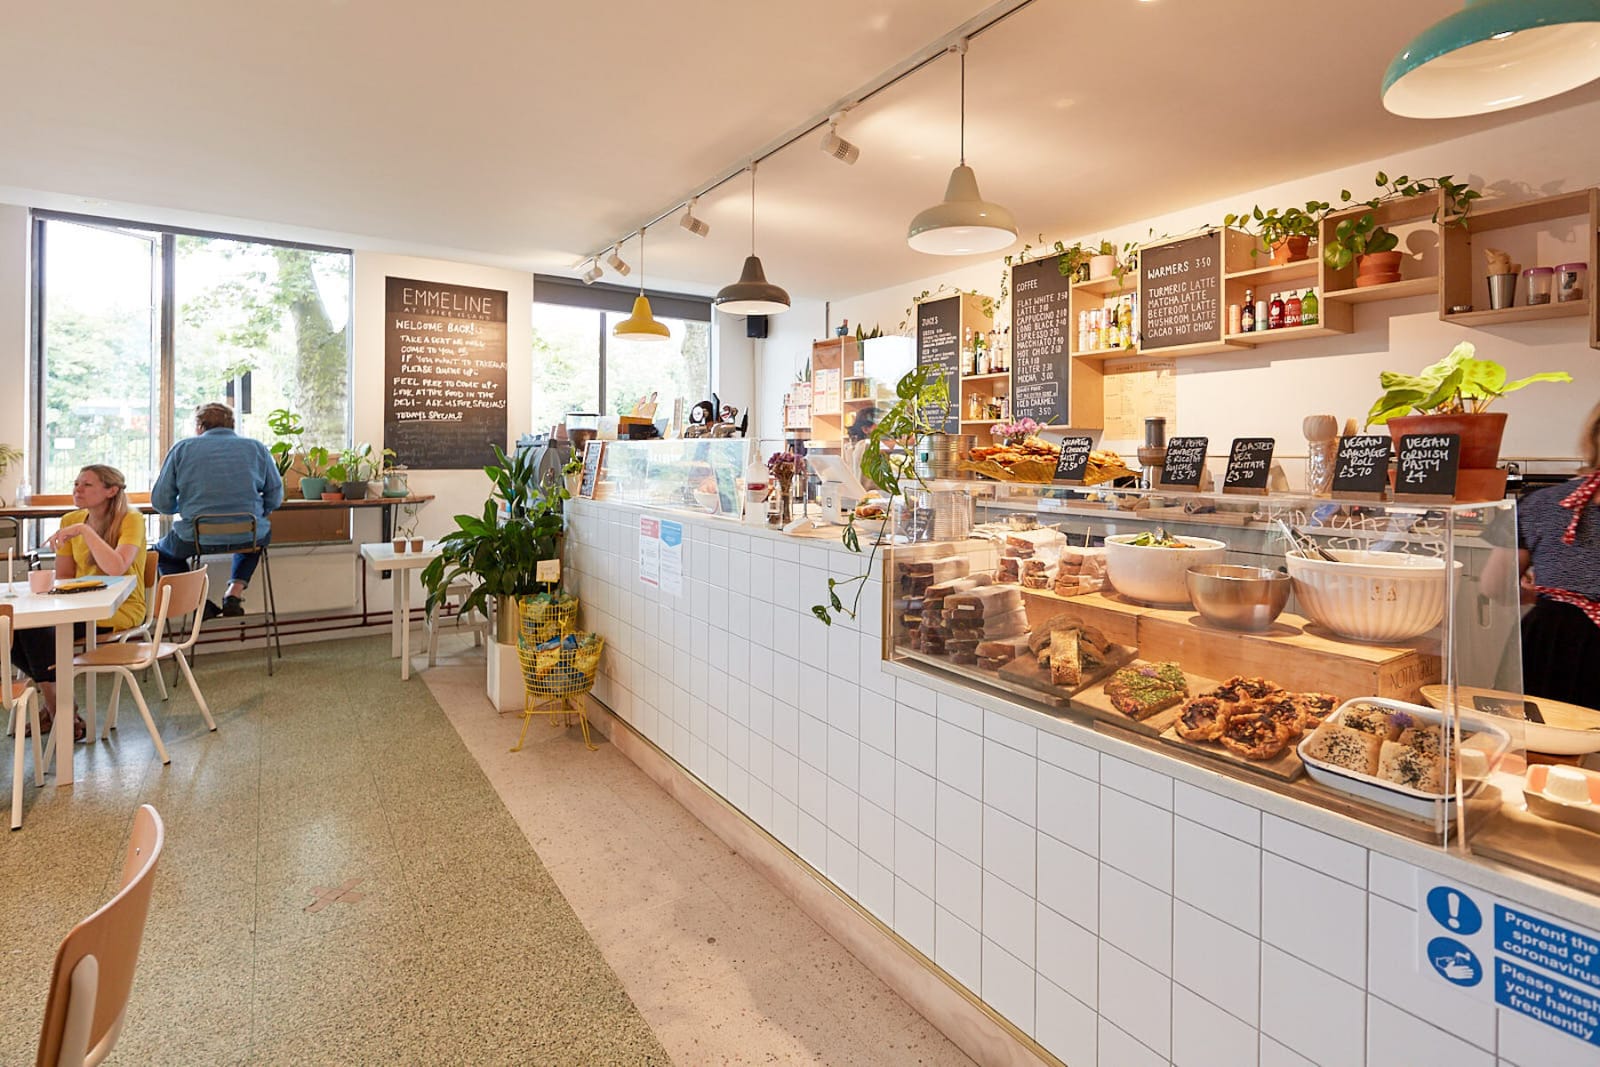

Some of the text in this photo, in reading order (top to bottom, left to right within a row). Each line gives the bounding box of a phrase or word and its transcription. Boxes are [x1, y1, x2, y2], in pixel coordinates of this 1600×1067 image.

[1147, 260, 1190, 279] WARMERS
[1016, 279, 1038, 292] COFFEE
[1148, 276, 1217, 298] TURMERIC LATTE
[403, 287, 492, 315] EMMELINE
[1017, 298, 1032, 309] FLAT
[1033, 293, 1055, 305] WHITE
[1147, 289, 1208, 309] MATCHA LATTE
[1016, 304, 1037, 317] LATTE
[1147, 298, 1217, 319] BEETROOT LATTE
[1016, 311, 1054, 326] CAPPUCCINO
[1147, 309, 1217, 328] MUSHROOM LATTE
[395, 319, 443, 332] WELCOME
[1016, 323, 1032, 335] LONG
[1034, 319, 1054, 331] BLACK
[1147, 326, 1173, 338] CACAO
[400, 335, 422, 344] TAKE
[424, 336, 430, 344] A
[1016, 329, 1049, 342] ESPRESSO
[400, 345, 425, 354] COME
[427, 346, 437, 354] TO
[438, 347, 454, 356] YOU
[1016, 350, 1029, 358] HOT
[1031, 345, 1049, 357] CHOC
[401, 355, 412, 363] IF
[415, 355, 433, 364] YOU
[1017, 358, 1030, 367] TEA
[401, 365, 433, 374] PLEASE
[1017, 364, 1041, 376] FILTER
[393, 377, 420, 387] FEEL
[444, 380, 455, 389] TO
[456, 381, 480, 389] COME
[1017, 373, 1037, 384] MOCHA
[416, 388, 427, 396] AT
[444, 390, 465, 399] FOOD
[477, 391, 495, 399] THE
[394, 399, 416, 408] DELI
[1016, 408, 1034, 417] LATTE
[1235, 441, 1274, 453] ROASTED
[1344, 436, 1383, 449] VEGAN
[1406, 436, 1450, 450] VEGAN
[1339, 447, 1388, 459] SAUSAGE
[1400, 449, 1449, 461] CORNISH
[1351, 456, 1375, 467] ROLL
[1402, 459, 1440, 471] PASTY
[1405, 470, 1428, 483] £4
[1269, 507, 1324, 530] KIDS
[1505, 911, 1599, 955] Prevent the
[1512, 930, 1591, 967] spread of
[1501, 963, 1600, 1014] Please wash
[1505, 981, 1599, 1027] your hands
[1510, 994, 1593, 1040] frequently
